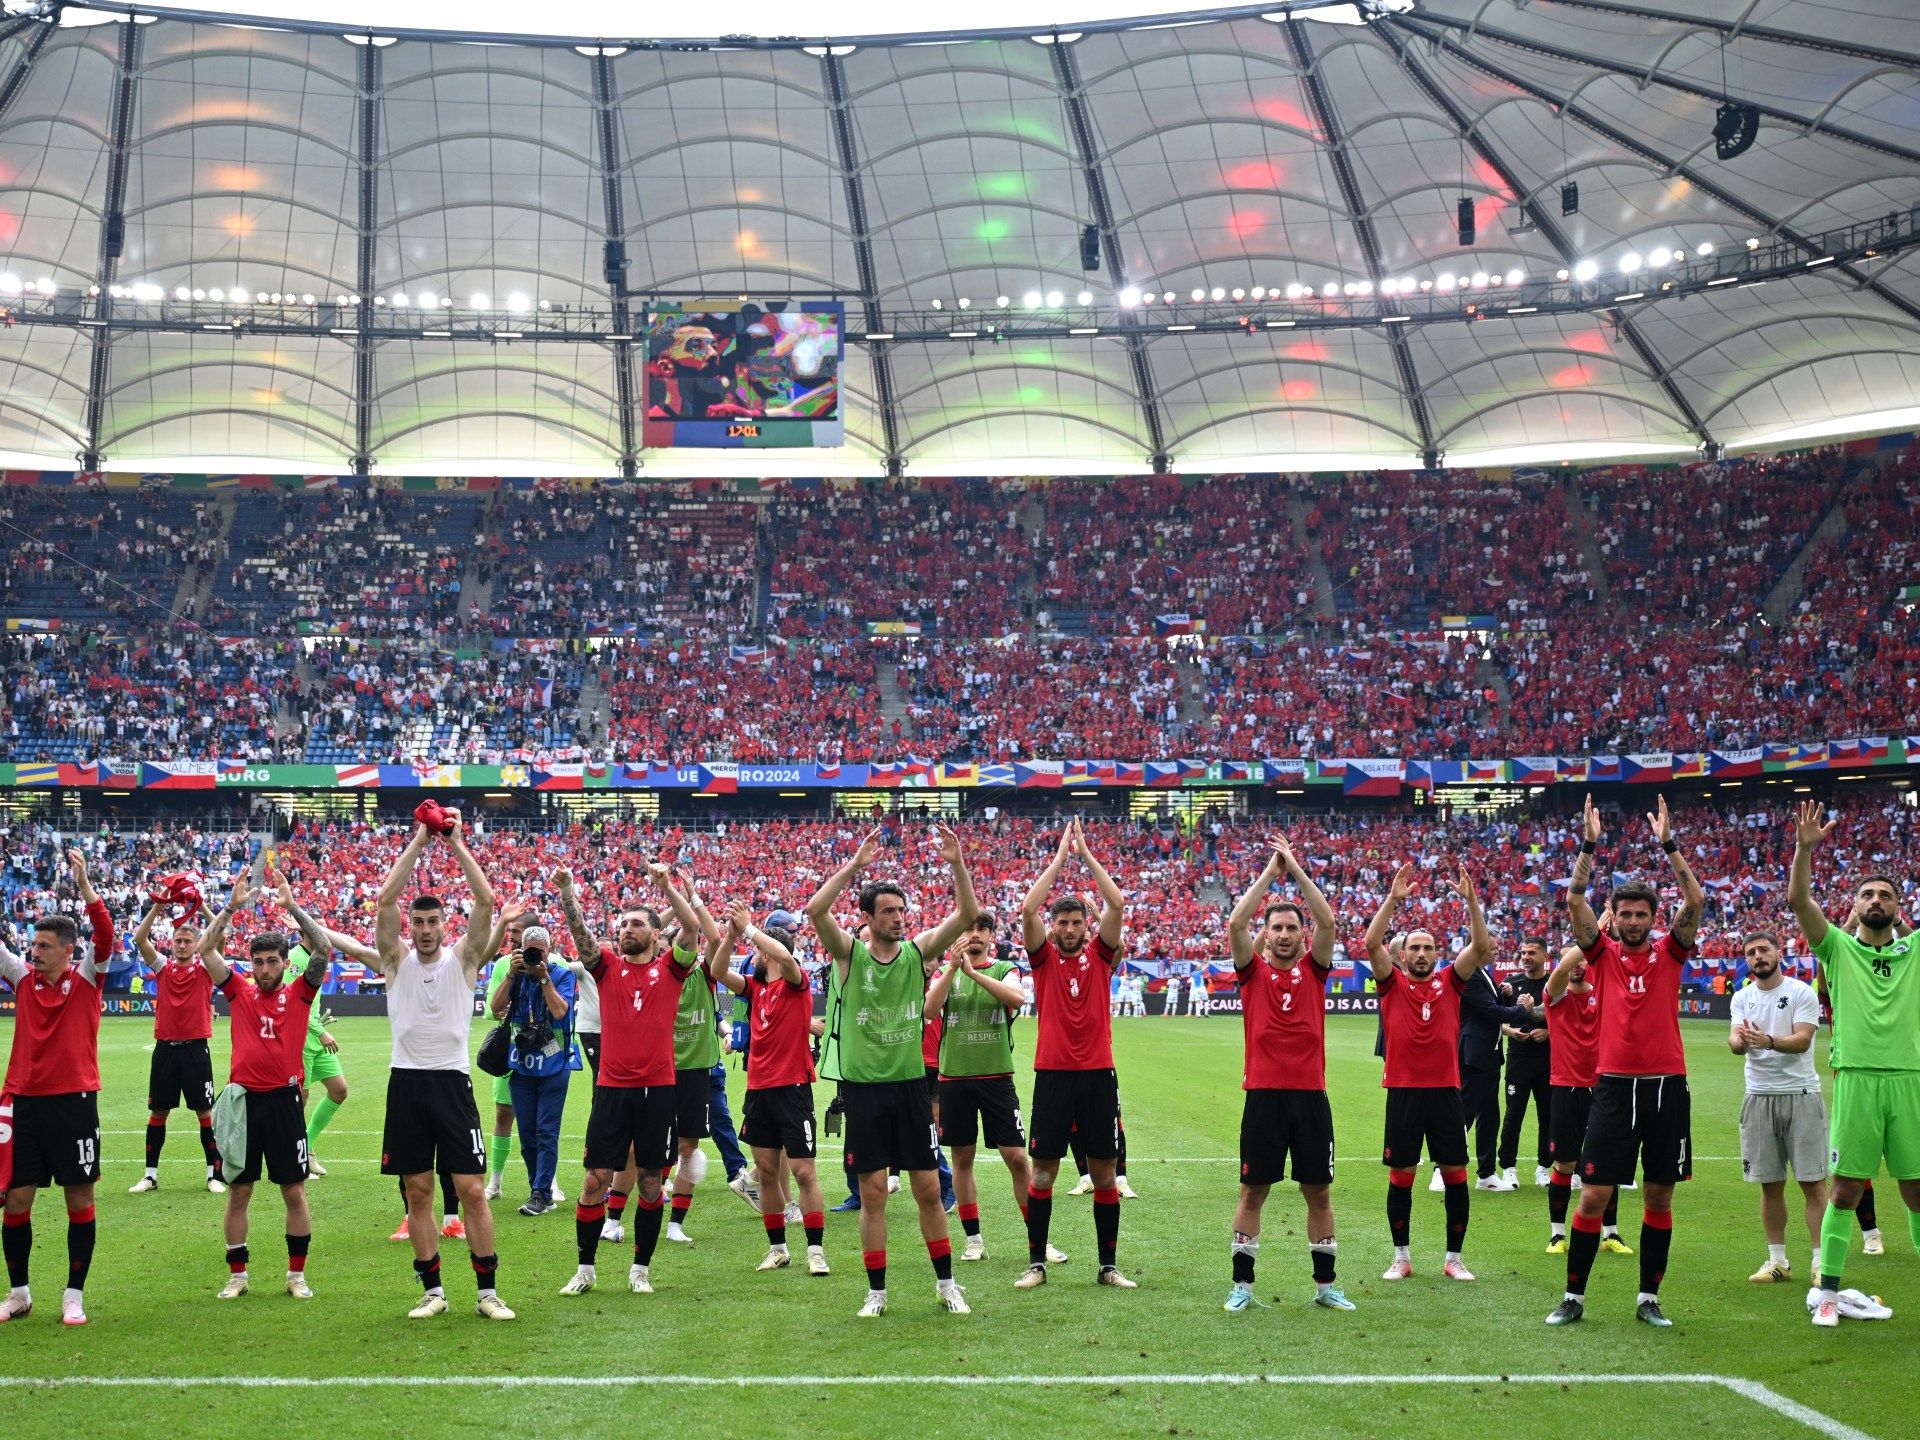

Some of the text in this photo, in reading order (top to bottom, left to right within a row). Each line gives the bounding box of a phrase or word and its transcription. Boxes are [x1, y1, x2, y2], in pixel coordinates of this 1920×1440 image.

[216, 767, 272, 782] BURG
[1362, 764, 1398, 772] BOLATICE
[1871, 958, 1892, 978] 25
[1068, 977, 1080, 998] 3
[632, 990, 643, 1011] 4
[1198, 999, 1243, 1011] BECAUS
[1282, 992, 1293, 1012] 2
[1338, 998, 1350, 1010] IS
[1352, 998, 1362, 1010] A
[1421, 1002, 1432, 1022] 6
[259, 1016, 276, 1039] 21
[967, 1032, 1001, 1041] RESPECT
[803, 1120, 813, 1142] 9
[76, 1138, 95, 1165] 13
[296, 1138, 308, 1164] 21
